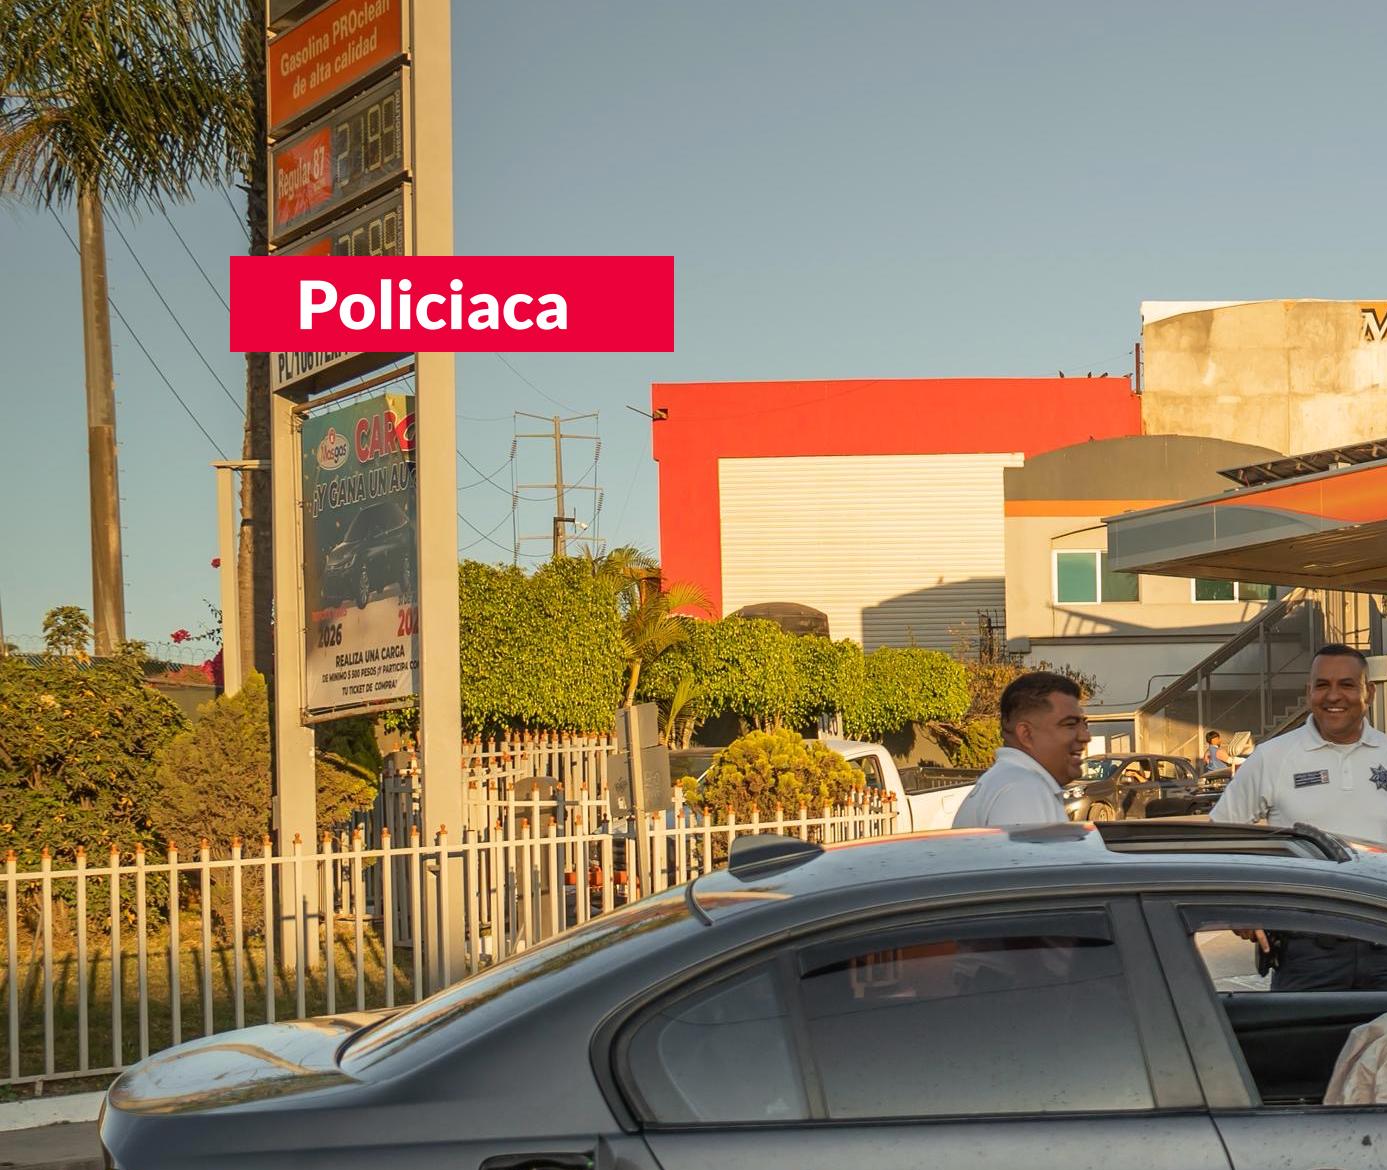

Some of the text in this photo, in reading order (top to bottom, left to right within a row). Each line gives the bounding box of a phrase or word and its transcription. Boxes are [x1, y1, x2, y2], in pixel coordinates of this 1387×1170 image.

[280, 0, 390, 77] Gasolina PROclean
[293, 27, 378, 99] de alta calidad
[278, 145, 325, 199] Regular 87
[328, 473, 366, 508] GANA
[369, 467, 387, 498] UN
[336, 644, 405, 667] REALIZA UNA CARGA
